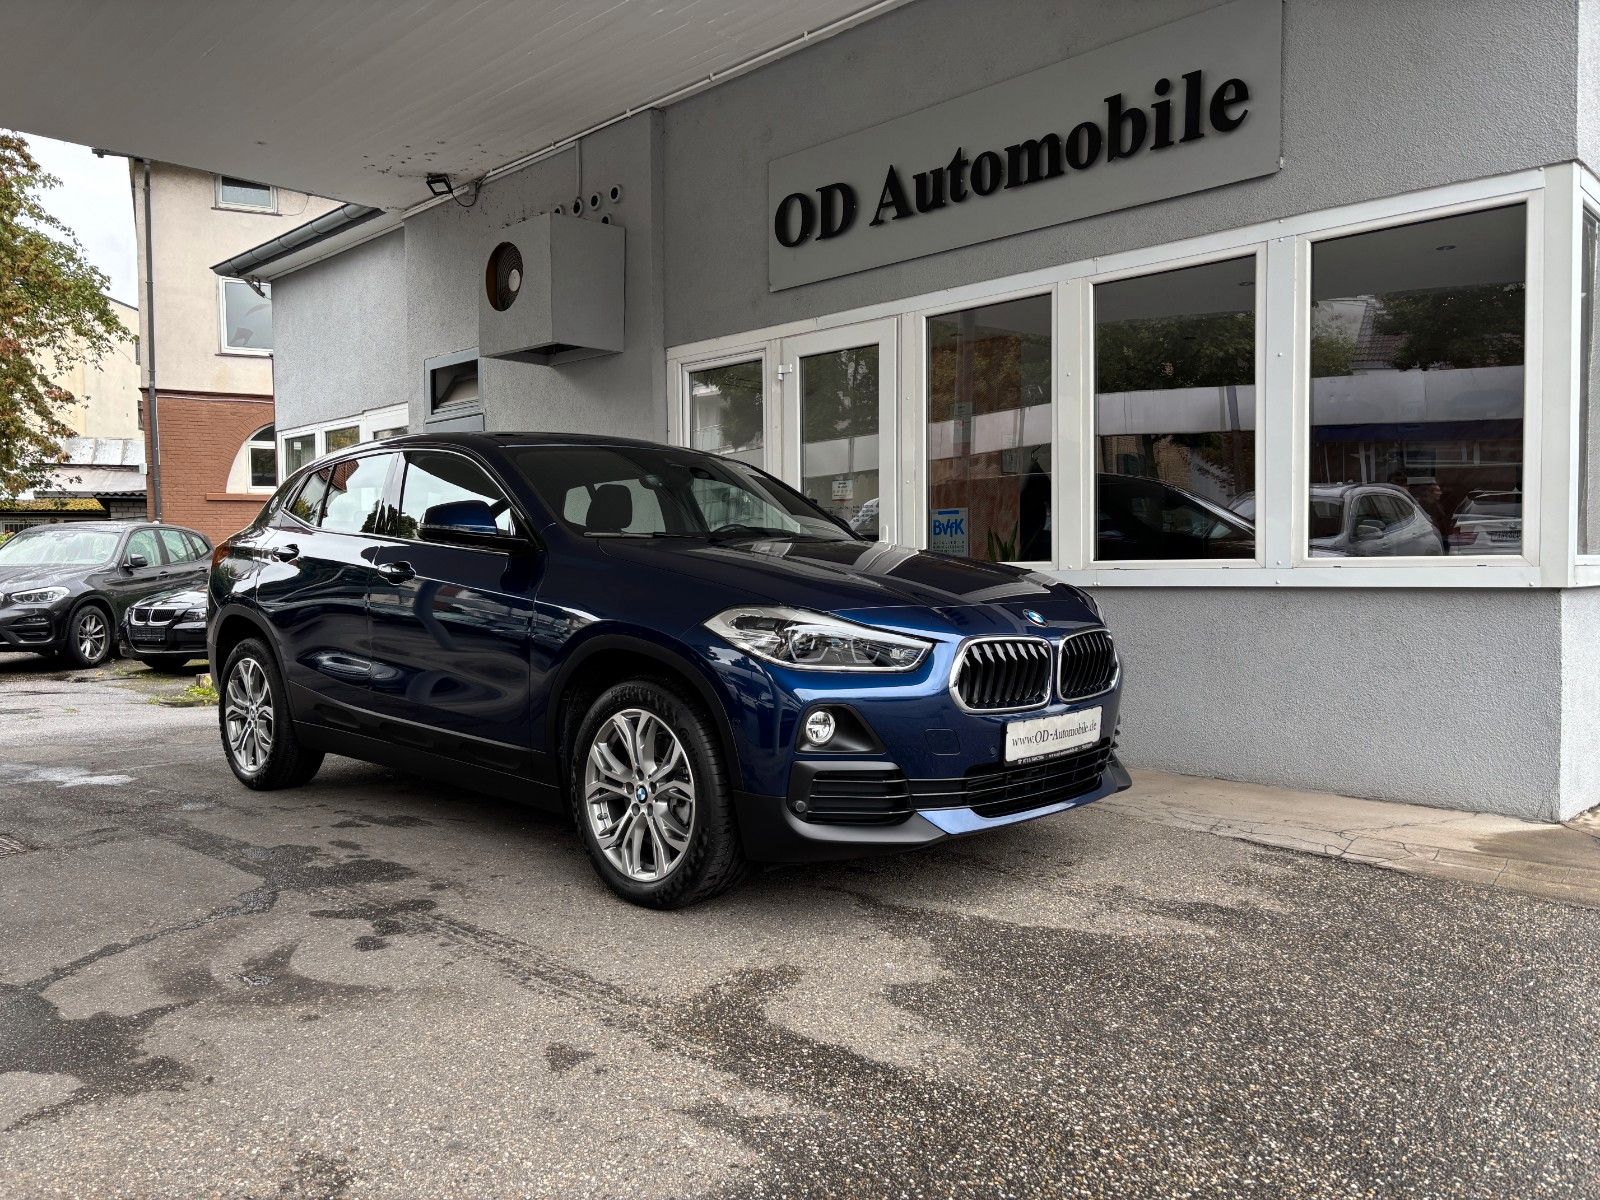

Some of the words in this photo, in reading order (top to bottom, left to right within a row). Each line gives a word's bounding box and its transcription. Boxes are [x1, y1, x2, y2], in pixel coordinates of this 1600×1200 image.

[774, 181, 857, 248] OD
[869, 69, 1250, 227] Automobile
[1012, 720, 1097, 746] www.OD-Automobile.de
